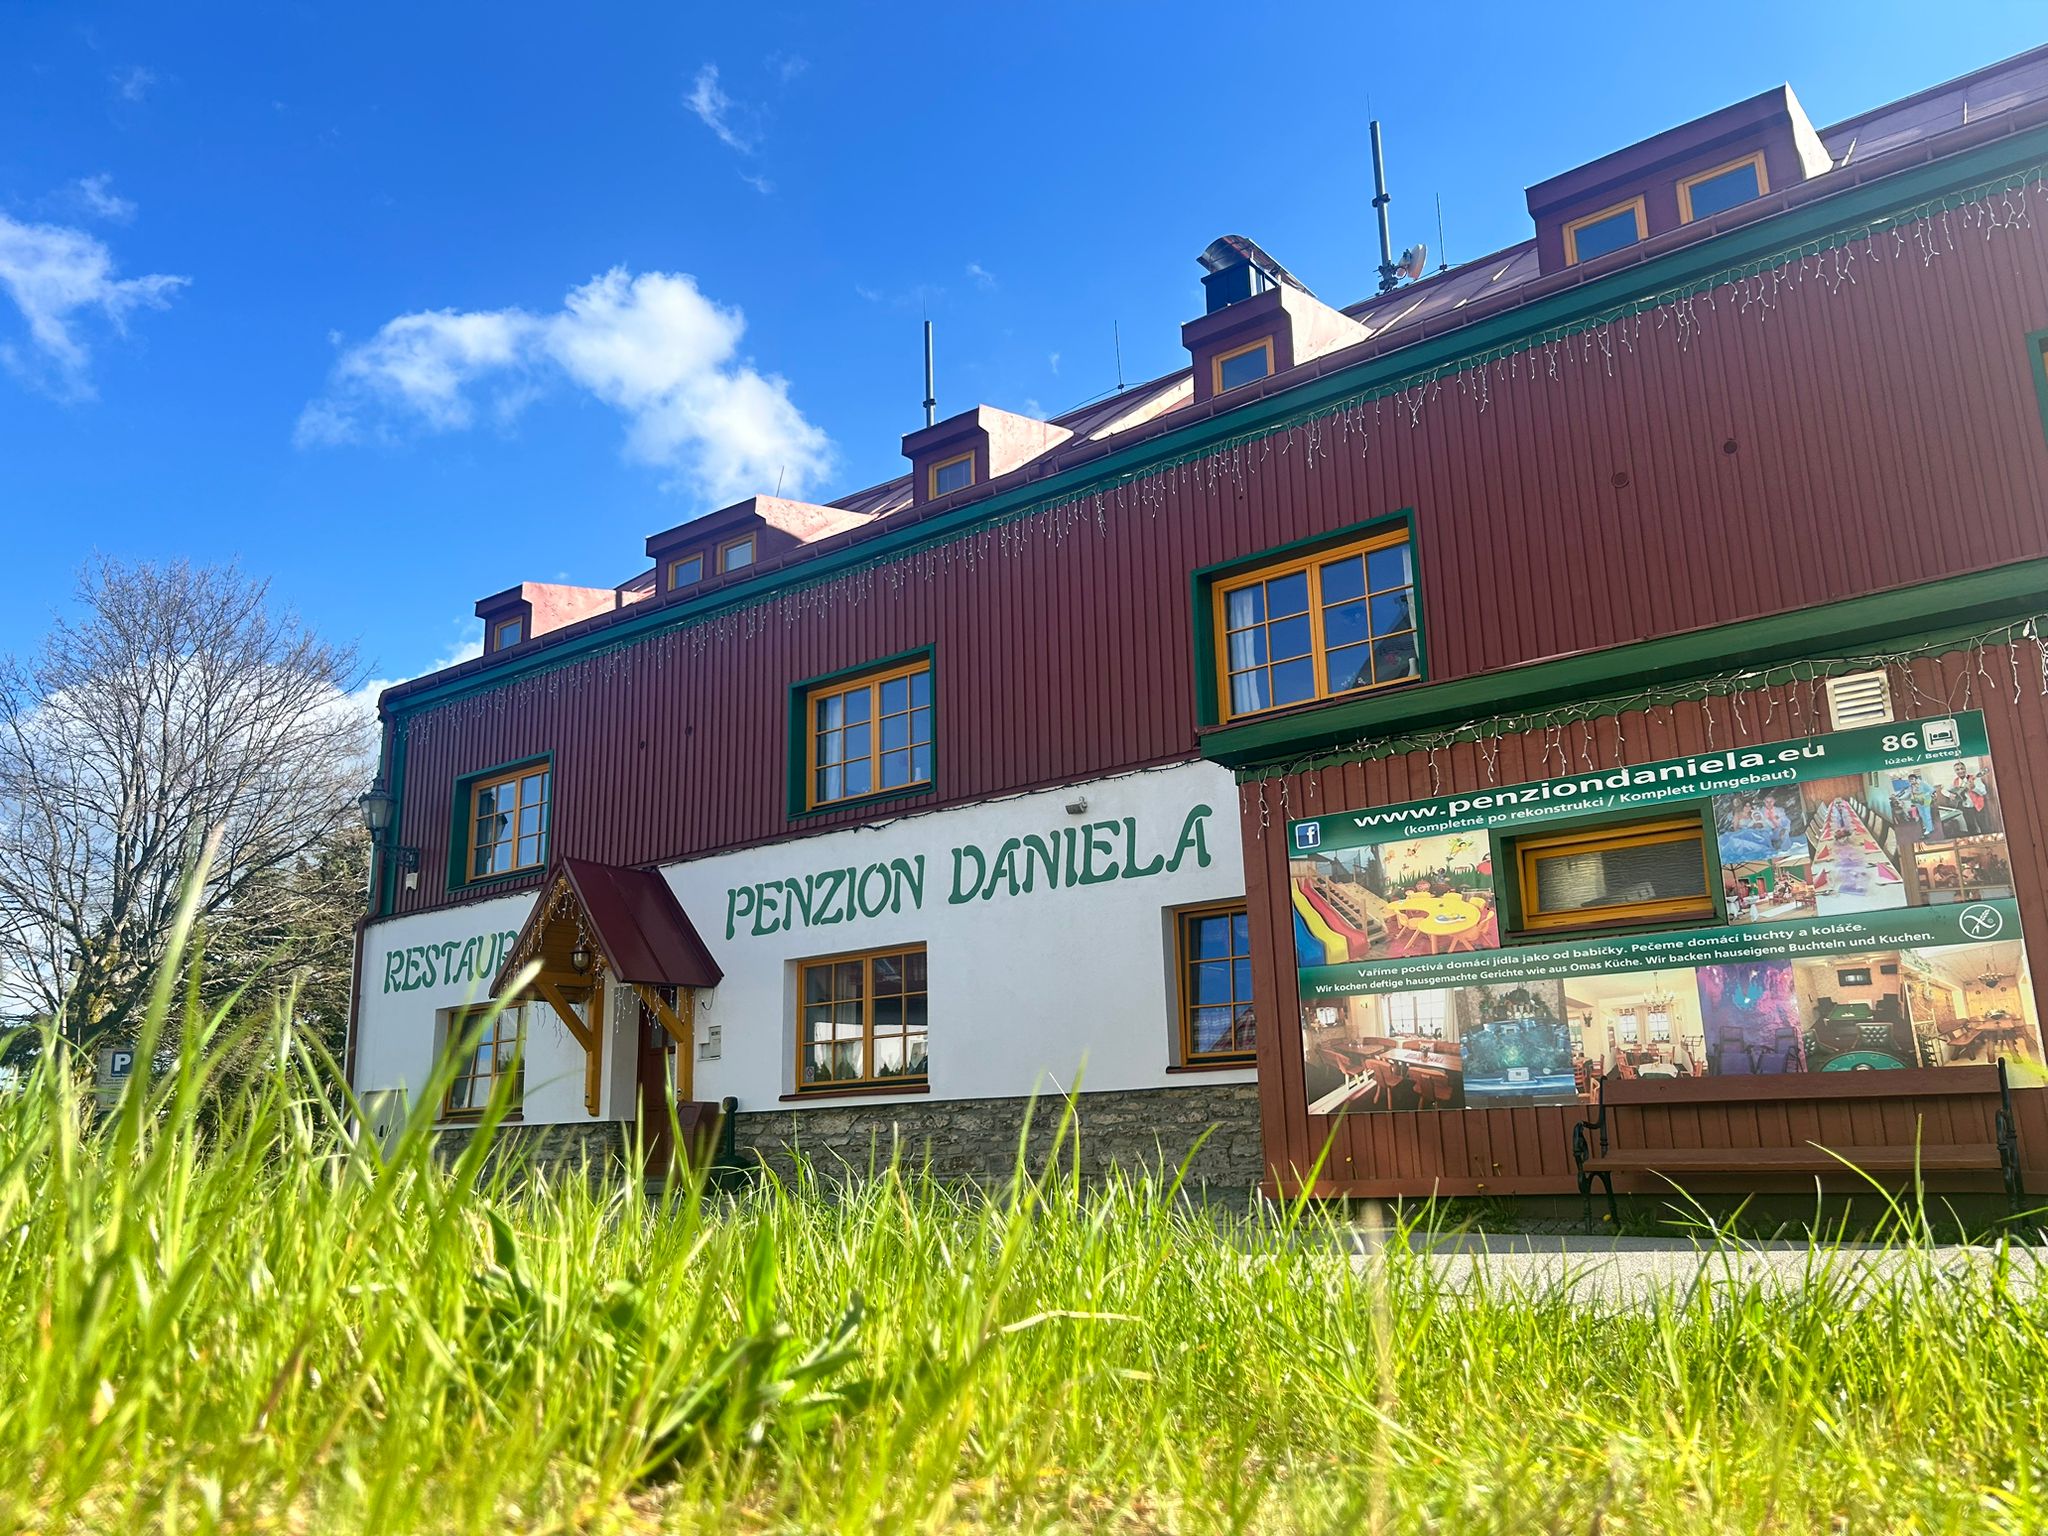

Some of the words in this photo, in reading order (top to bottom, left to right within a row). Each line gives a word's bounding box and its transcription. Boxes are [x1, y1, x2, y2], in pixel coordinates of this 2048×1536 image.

[1882, 732, 1918, 752] 86
[1353, 743, 1825, 828] www.penziondaniela.eu
[1404, 815, 1484, 837] (kompletně
[1488, 812, 1507, 824] po
[1511, 797, 1604, 819] rekonstrukci
[1620, 783, 1696, 804] Komplett
[1700, 767, 1797, 791] Umgebaut)
[726, 854, 925, 940] PENZION
[948, 803, 1213, 904] DANIELA
[1315, 984, 1333, 993] Wir
[1334, 981, 1368, 992] kochen
[1370, 977, 1404, 989] deftige
[1406, 973, 1478, 987] hausgemachte
[1480, 968, 1524, 980] Gerichte
[1526, 966, 1546, 975] wie
[1549, 964, 1567, 973] aus
[1570, 961, 1602, 971] Omas
[1605, 957, 1643, 969] Küche.
[1645, 955, 1666, 965] Wir
[1669, 951, 1712, 963] backen
[1715, 945, 1785, 959] hauseigene
[1789, 938, 1846, 952] Buchteln
[1850, 936, 1876, 948] und
[1879, 931, 1935, 944] Kuchen.
[1358, 965, 1398, 978] Vaříme
[1401, 962, 1444, 975] poctivá
[1446, 955, 1490, 970] domácí
[1492, 953, 1519, 967] jídla
[1522, 952, 1550, 964] jako
[1552, 949, 1570, 960] od
[1573, 944, 1628, 958] babičky.
[1631, 941, 1684, 953] Pečeme
[1688, 934, 1739, 948] domácí
[1743, 925, 1794, 942] buchty
[1799, 928, 1808, 937] a
[1812, 922, 1867, 936] koláče.
[114, 1053, 131, 1072] P
